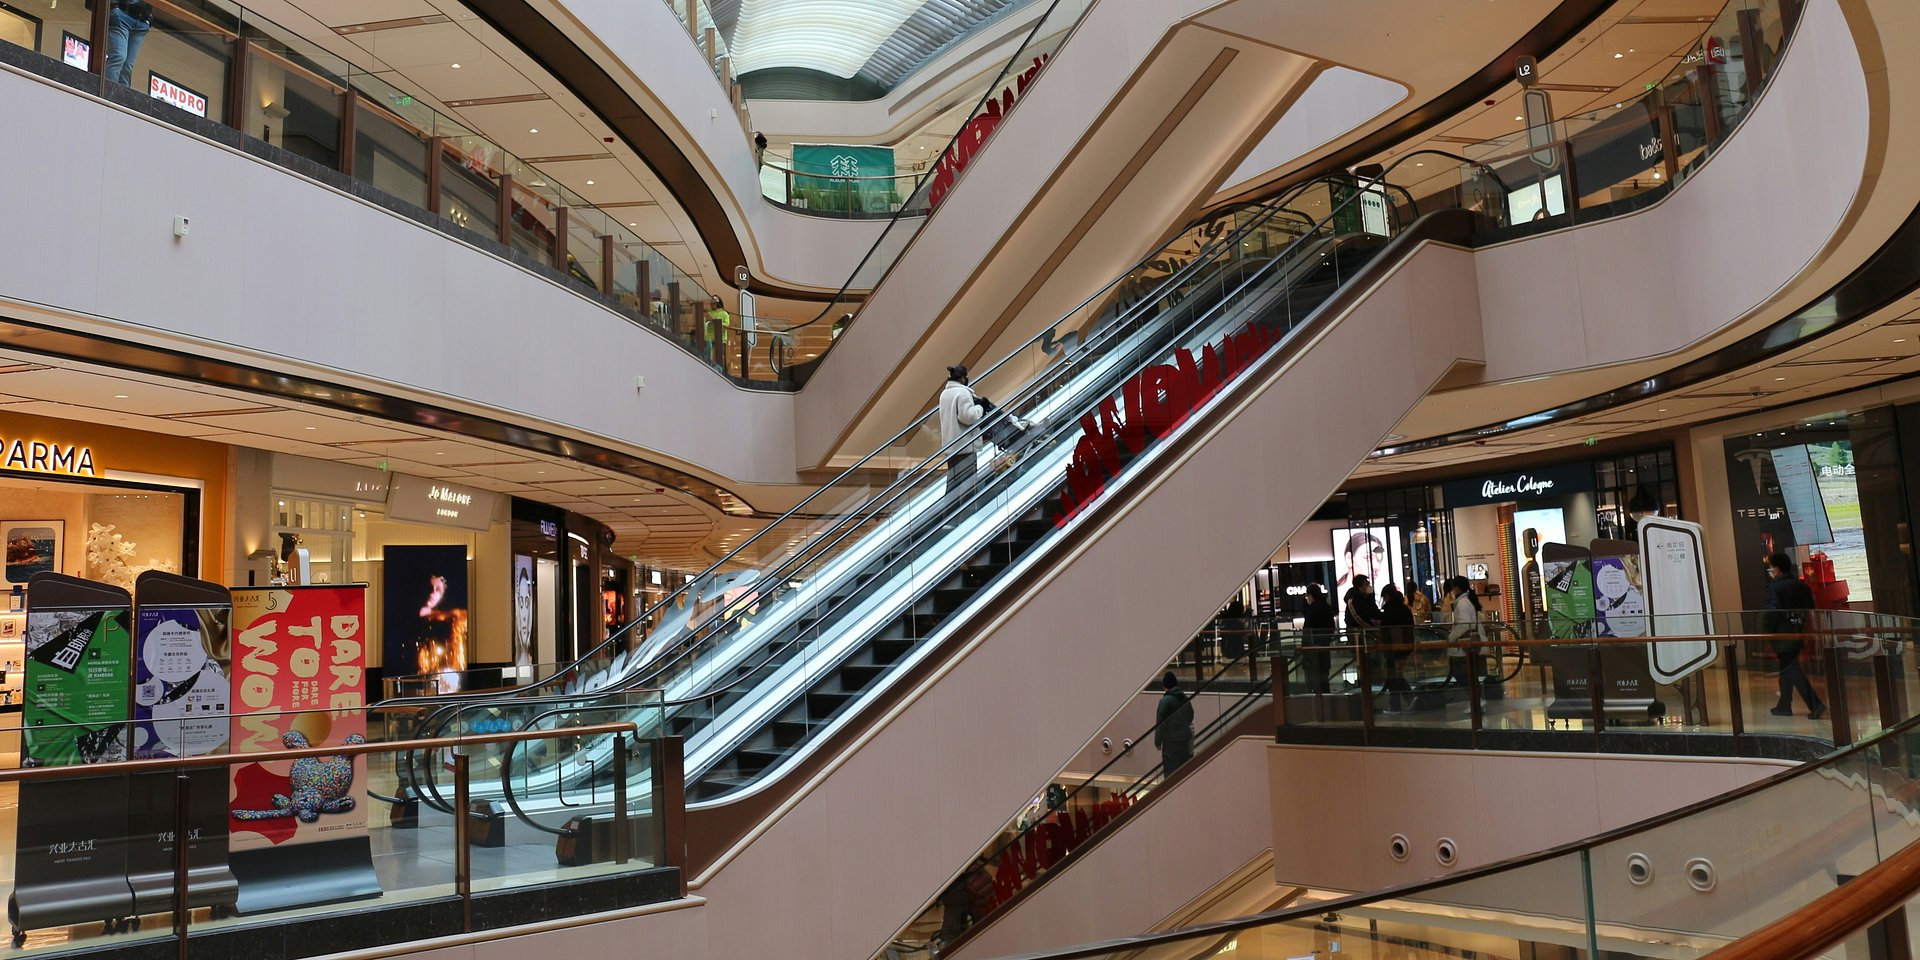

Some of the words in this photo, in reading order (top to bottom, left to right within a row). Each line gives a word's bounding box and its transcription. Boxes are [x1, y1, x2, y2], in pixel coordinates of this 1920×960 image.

[151, 78, 205, 112] SANDRO
[1481, 479, 1517, 499] Atelier
[1516, 474, 1554, 495] Cologne
[1286, 585, 1328, 596] CHAL
[287, 615, 323, 679] TO
[329, 615, 362, 721] DARE
[238, 620, 282, 754] WOW
[292, 681, 300, 709] MORE
[301, 681, 309, 701] FOR
[310, 680, 319, 707] DARE
[158, 828, 202, 843] 兴业汇
